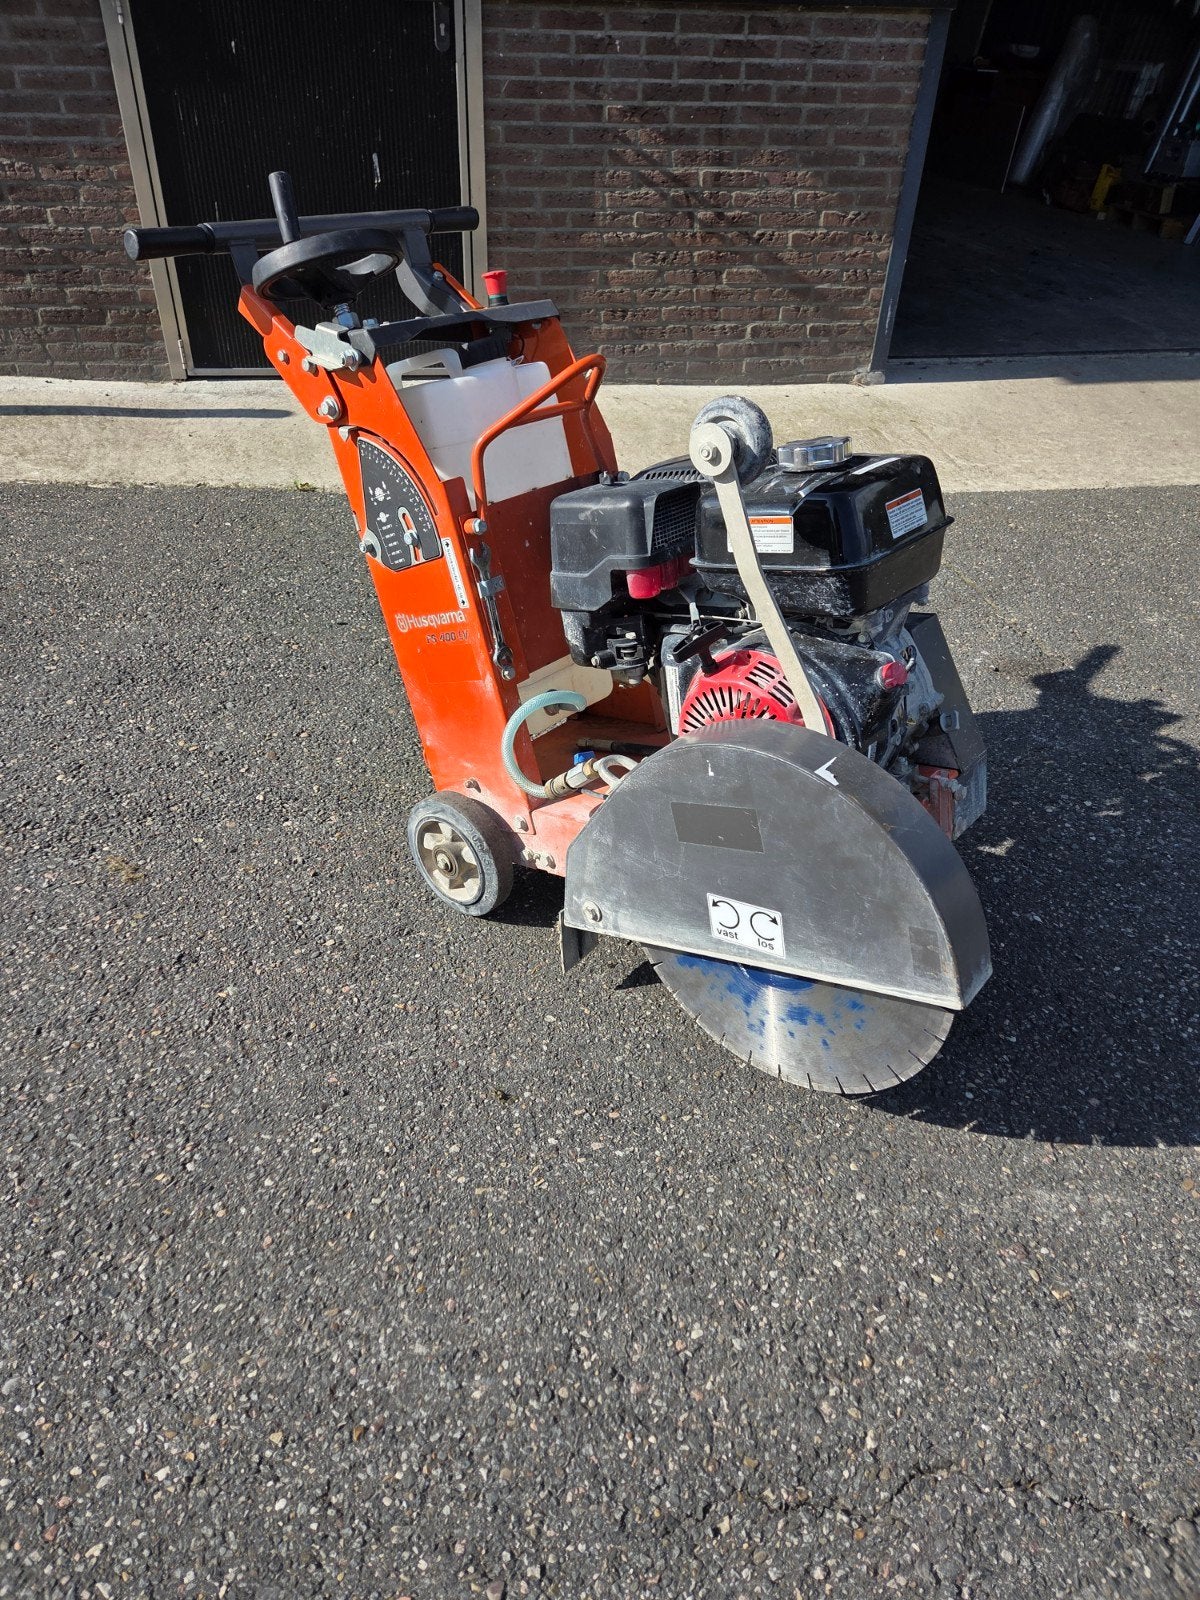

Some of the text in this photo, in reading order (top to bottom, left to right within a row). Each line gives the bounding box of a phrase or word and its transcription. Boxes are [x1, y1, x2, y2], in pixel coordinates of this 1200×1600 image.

[405, 610, 466, 628] Husqvarna
[440, 631, 457, 642] 400
[716, 928, 739, 940] vast
[757, 938, 775, 951] los
